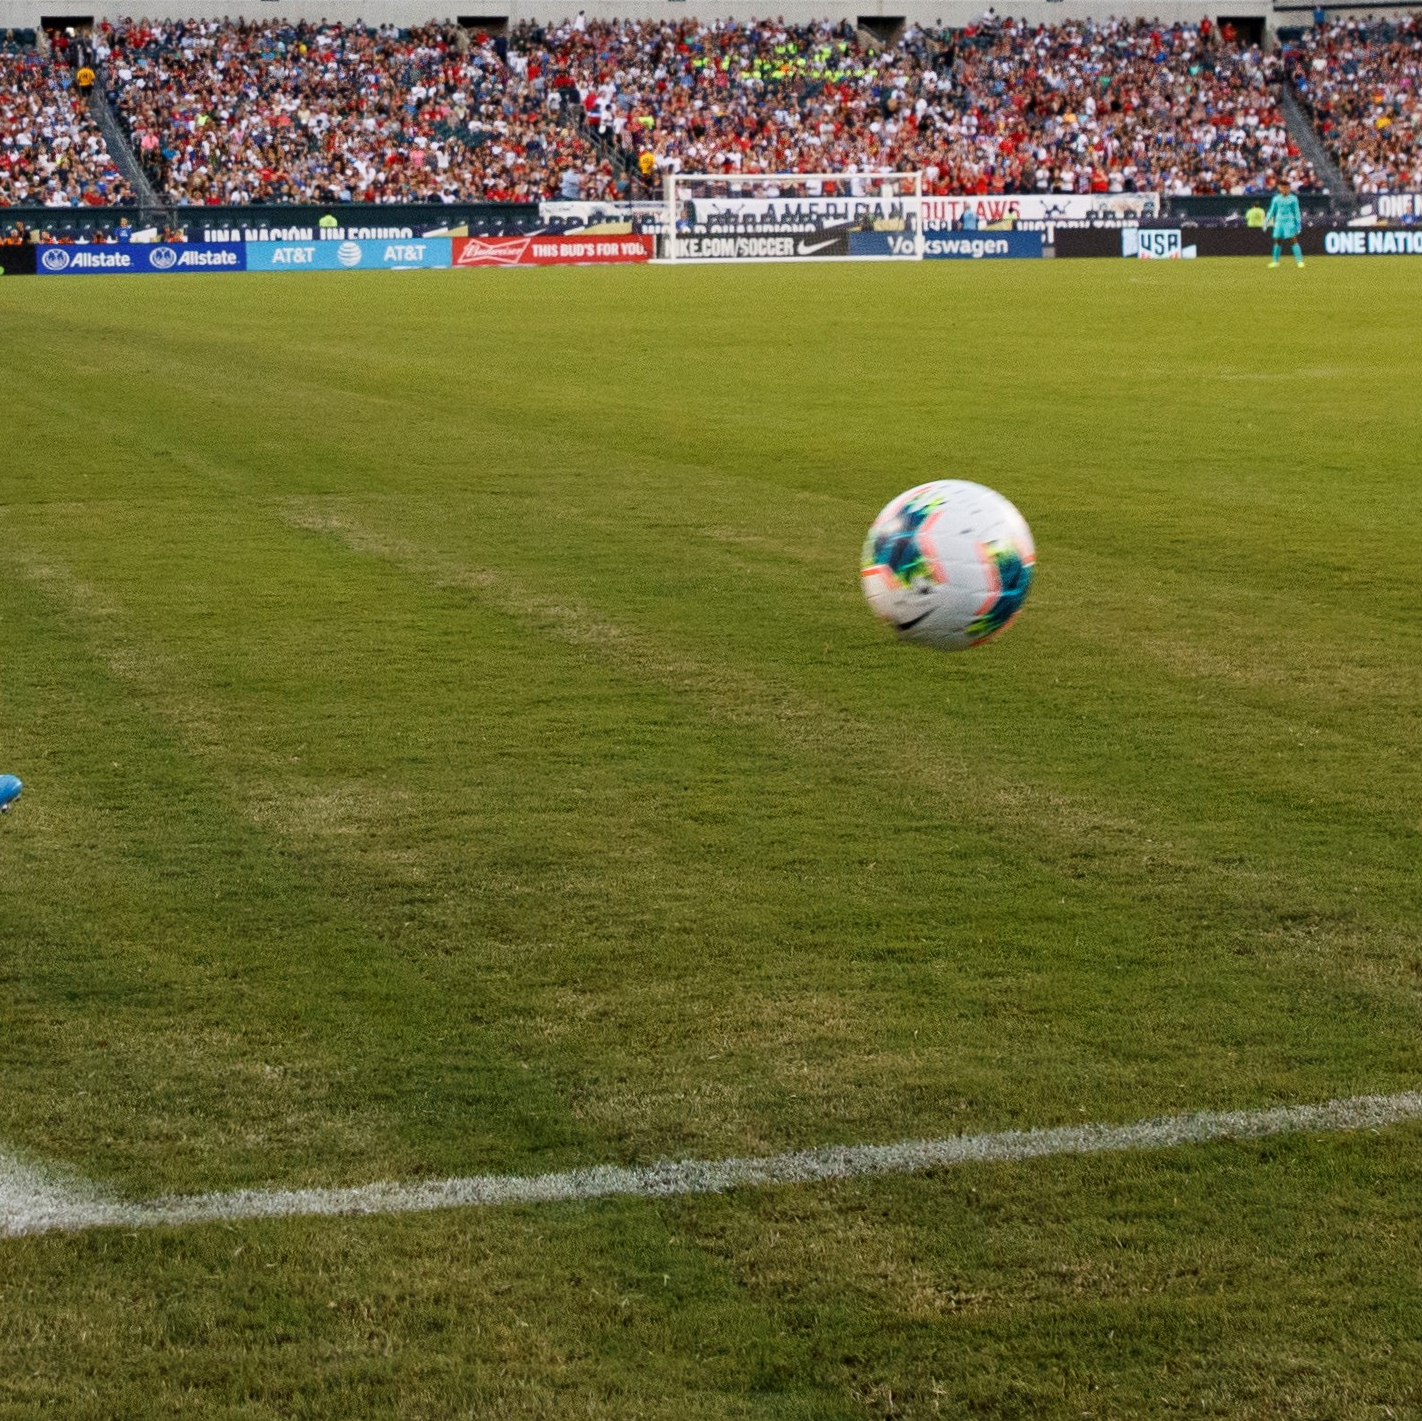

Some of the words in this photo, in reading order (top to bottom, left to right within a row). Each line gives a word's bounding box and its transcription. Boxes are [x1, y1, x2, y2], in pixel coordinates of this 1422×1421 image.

[1379, 193, 1413, 217] ONE
[532, 244, 558, 258] THIS
[560, 243, 595, 258] BUD'S
[596, 242, 620, 256] FOR
[622, 241, 648, 256] YOU.
[1141, 234, 1178, 256] USA
[1325, 231, 1367, 253] ONE
[70, 252, 131, 267] Allstate
[178, 250, 238, 266] Allstate
[272, 247, 316, 264] AT&T
[383, 245, 427, 261] AT&T
[462, 244, 523, 259] Budweiser
